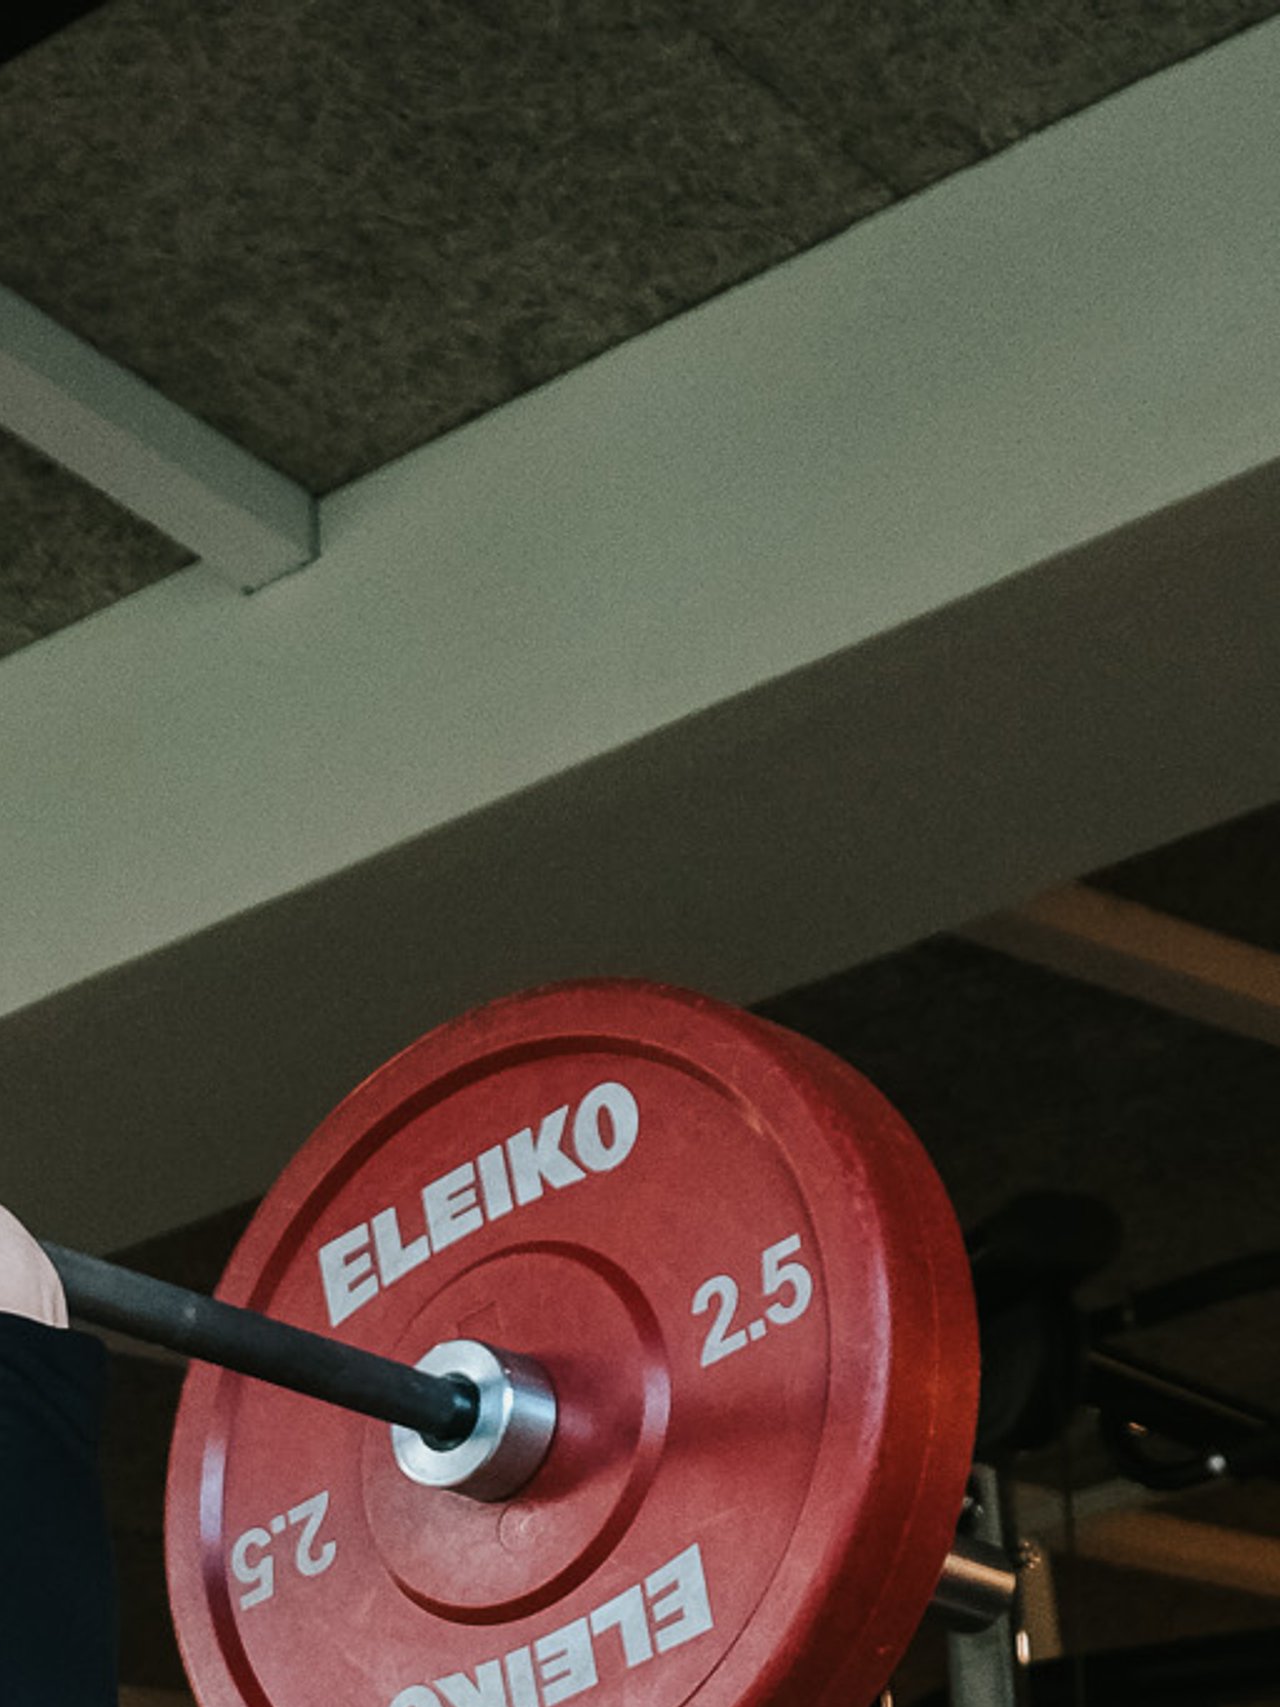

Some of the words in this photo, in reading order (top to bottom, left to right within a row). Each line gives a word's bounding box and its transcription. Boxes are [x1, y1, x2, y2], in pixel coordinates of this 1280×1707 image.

[317, 1081, 640, 1328] ELEIKO
[690, 1233, 814, 1369] 2.5
[230, 1491, 338, 1611] 2.5
